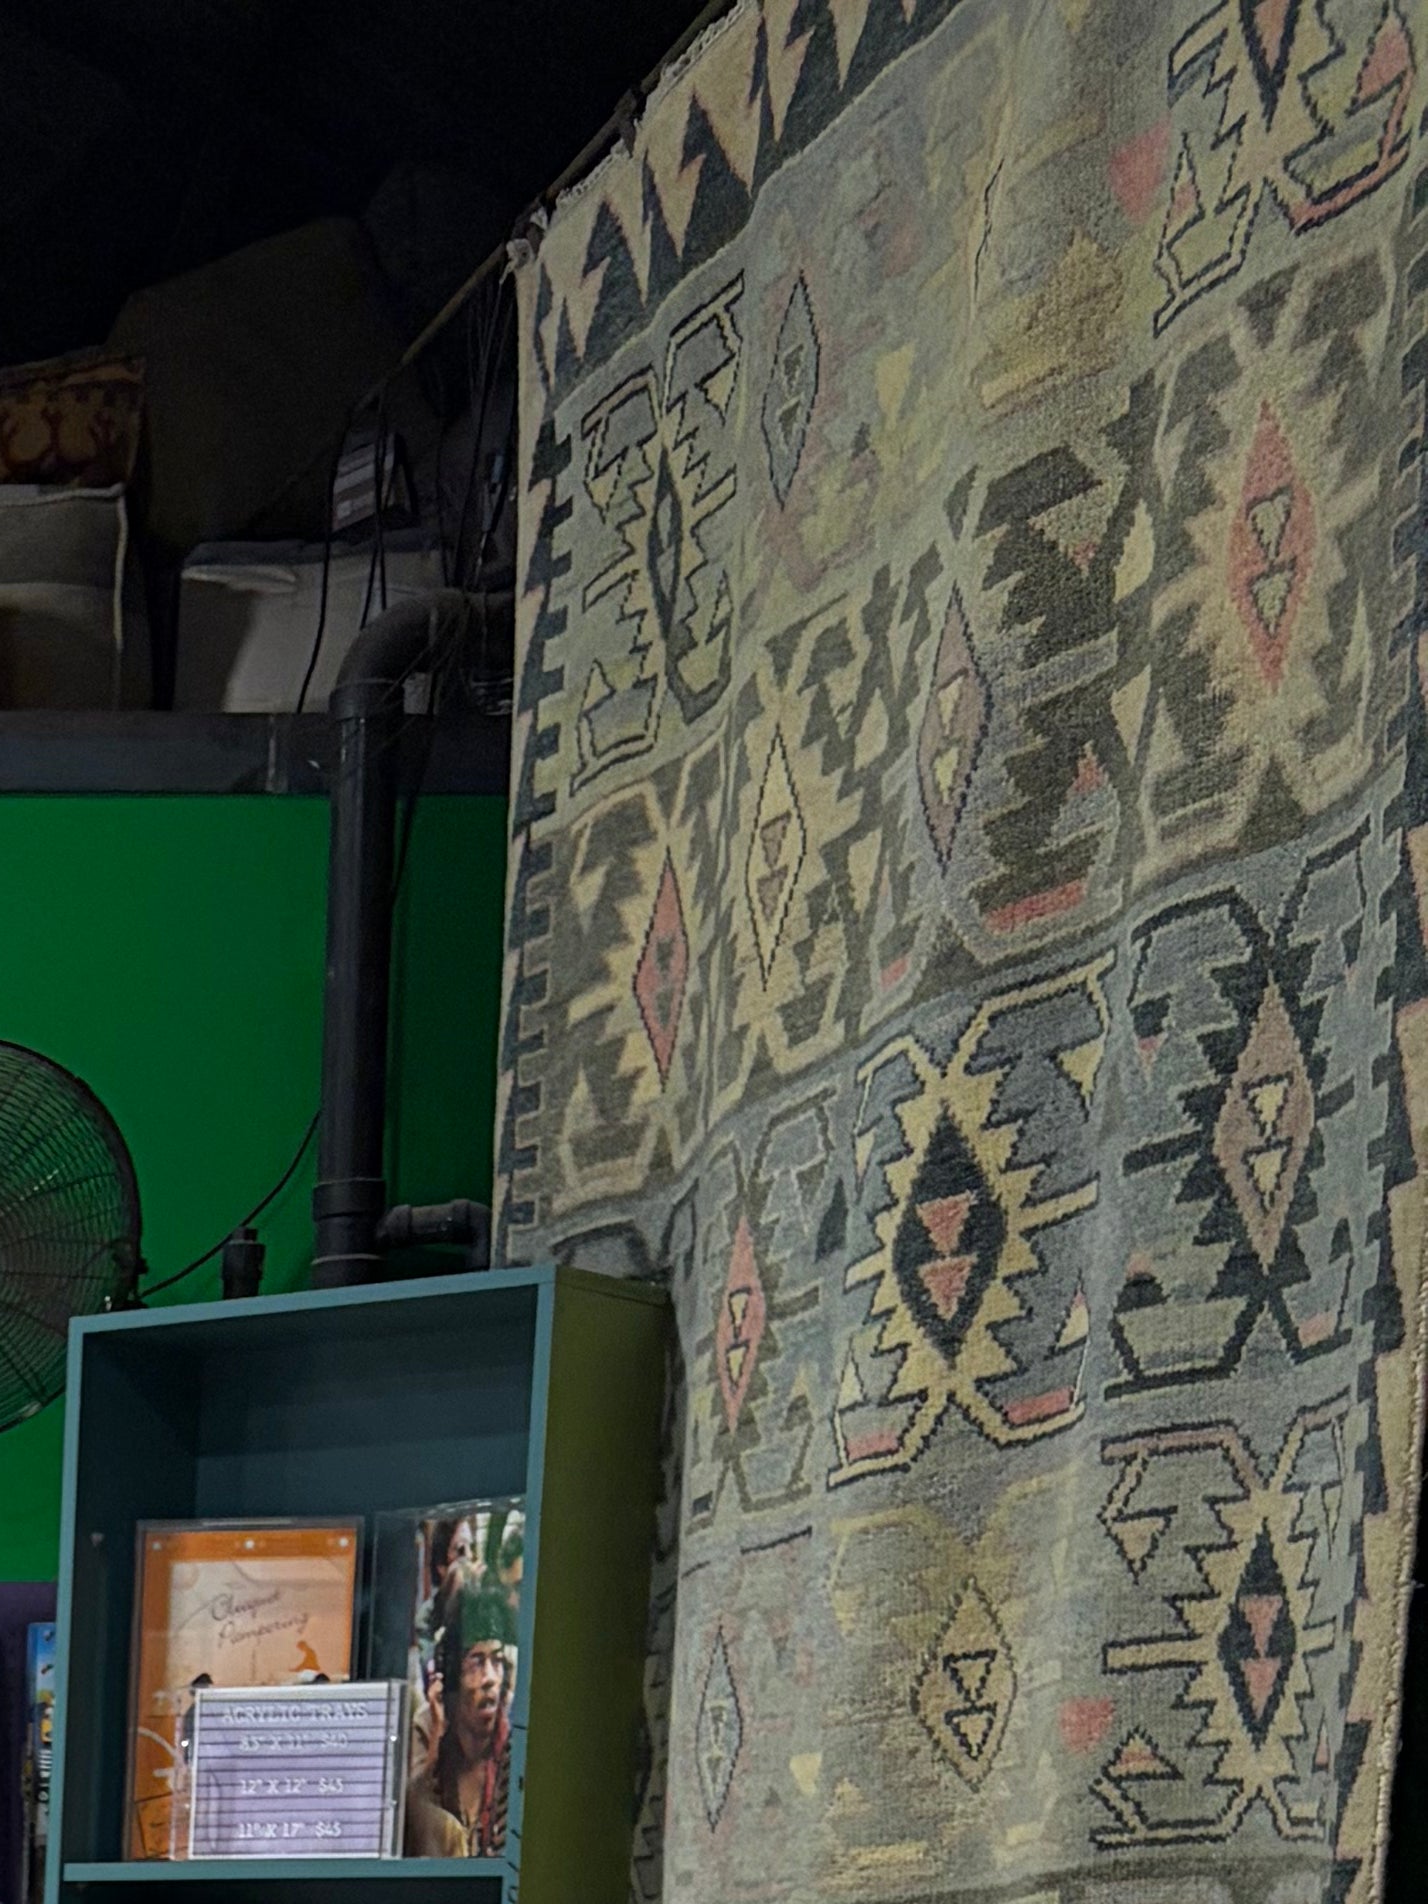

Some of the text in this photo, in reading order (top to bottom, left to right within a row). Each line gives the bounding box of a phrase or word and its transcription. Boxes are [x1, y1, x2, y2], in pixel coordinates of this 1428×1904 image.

[222, 1702, 369, 1724] ACRYLIC TRAYS
[269, 1735, 283, 1751] X
[266, 1778, 280, 1795] X
[318, 1776, 344, 1794] $45
[264, 1822, 278, 1838] X
[315, 1821, 343, 1838] $45
